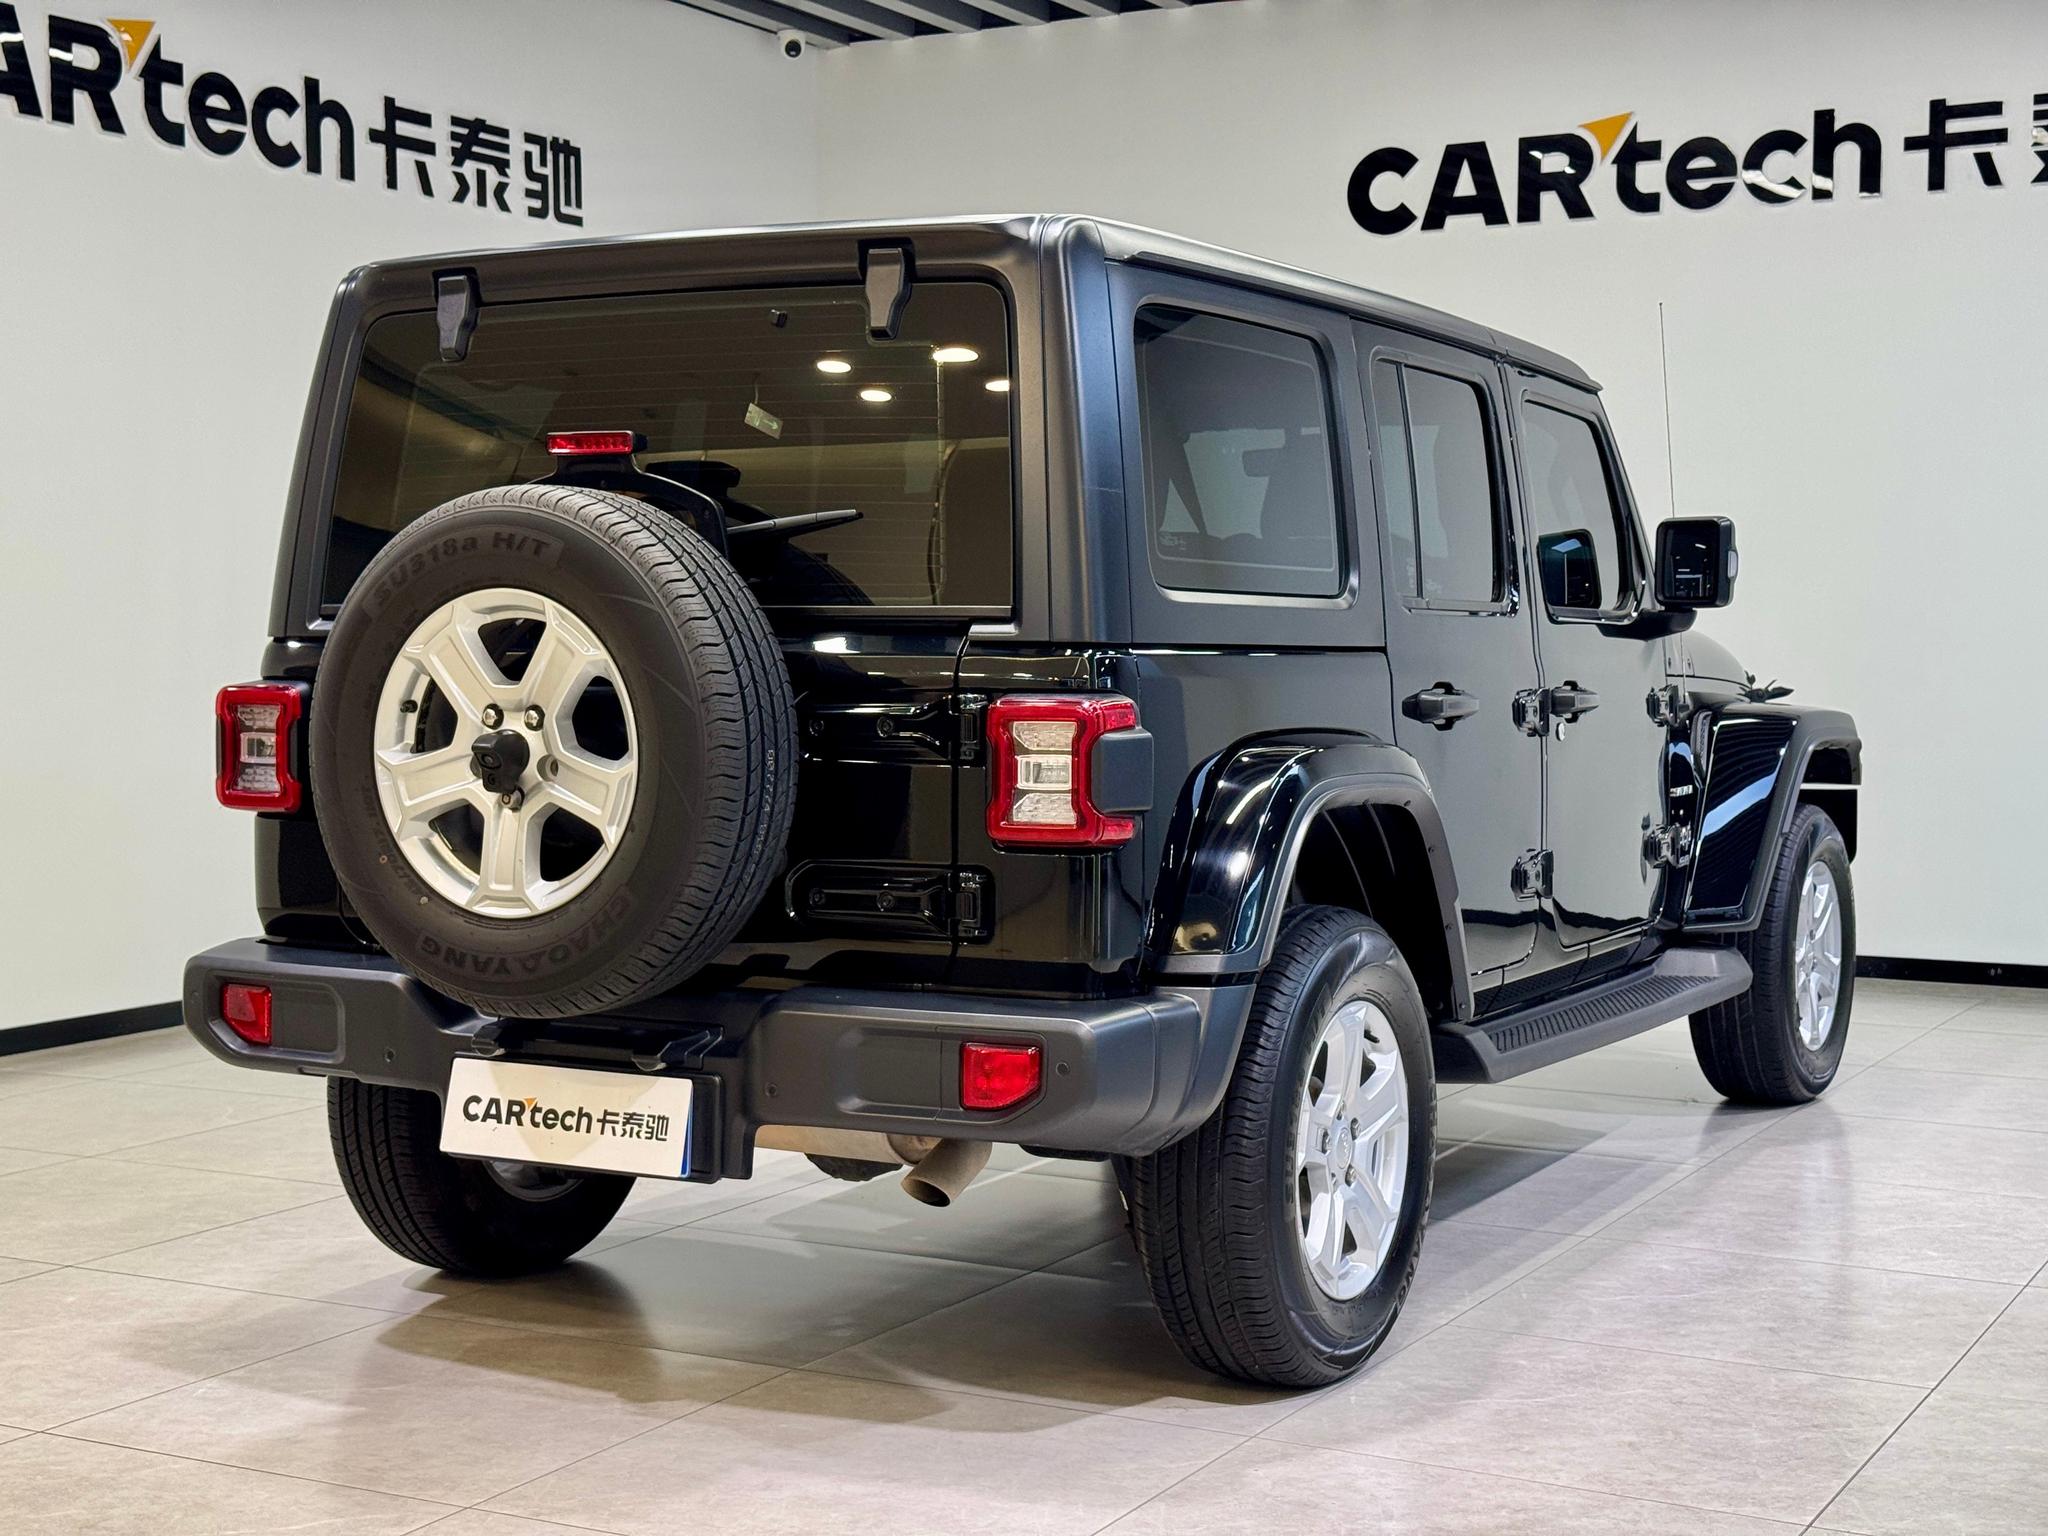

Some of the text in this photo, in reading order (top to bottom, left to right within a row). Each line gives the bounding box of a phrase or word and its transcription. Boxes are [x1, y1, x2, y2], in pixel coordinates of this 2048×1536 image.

[369, 96, 583, 227] 卡泰驰
[1347, 92, 2048, 236] CARtech 卡
[493, 531, 551, 557] H/T
[463, 1095, 669, 1142] CARtech 卡泰驰
